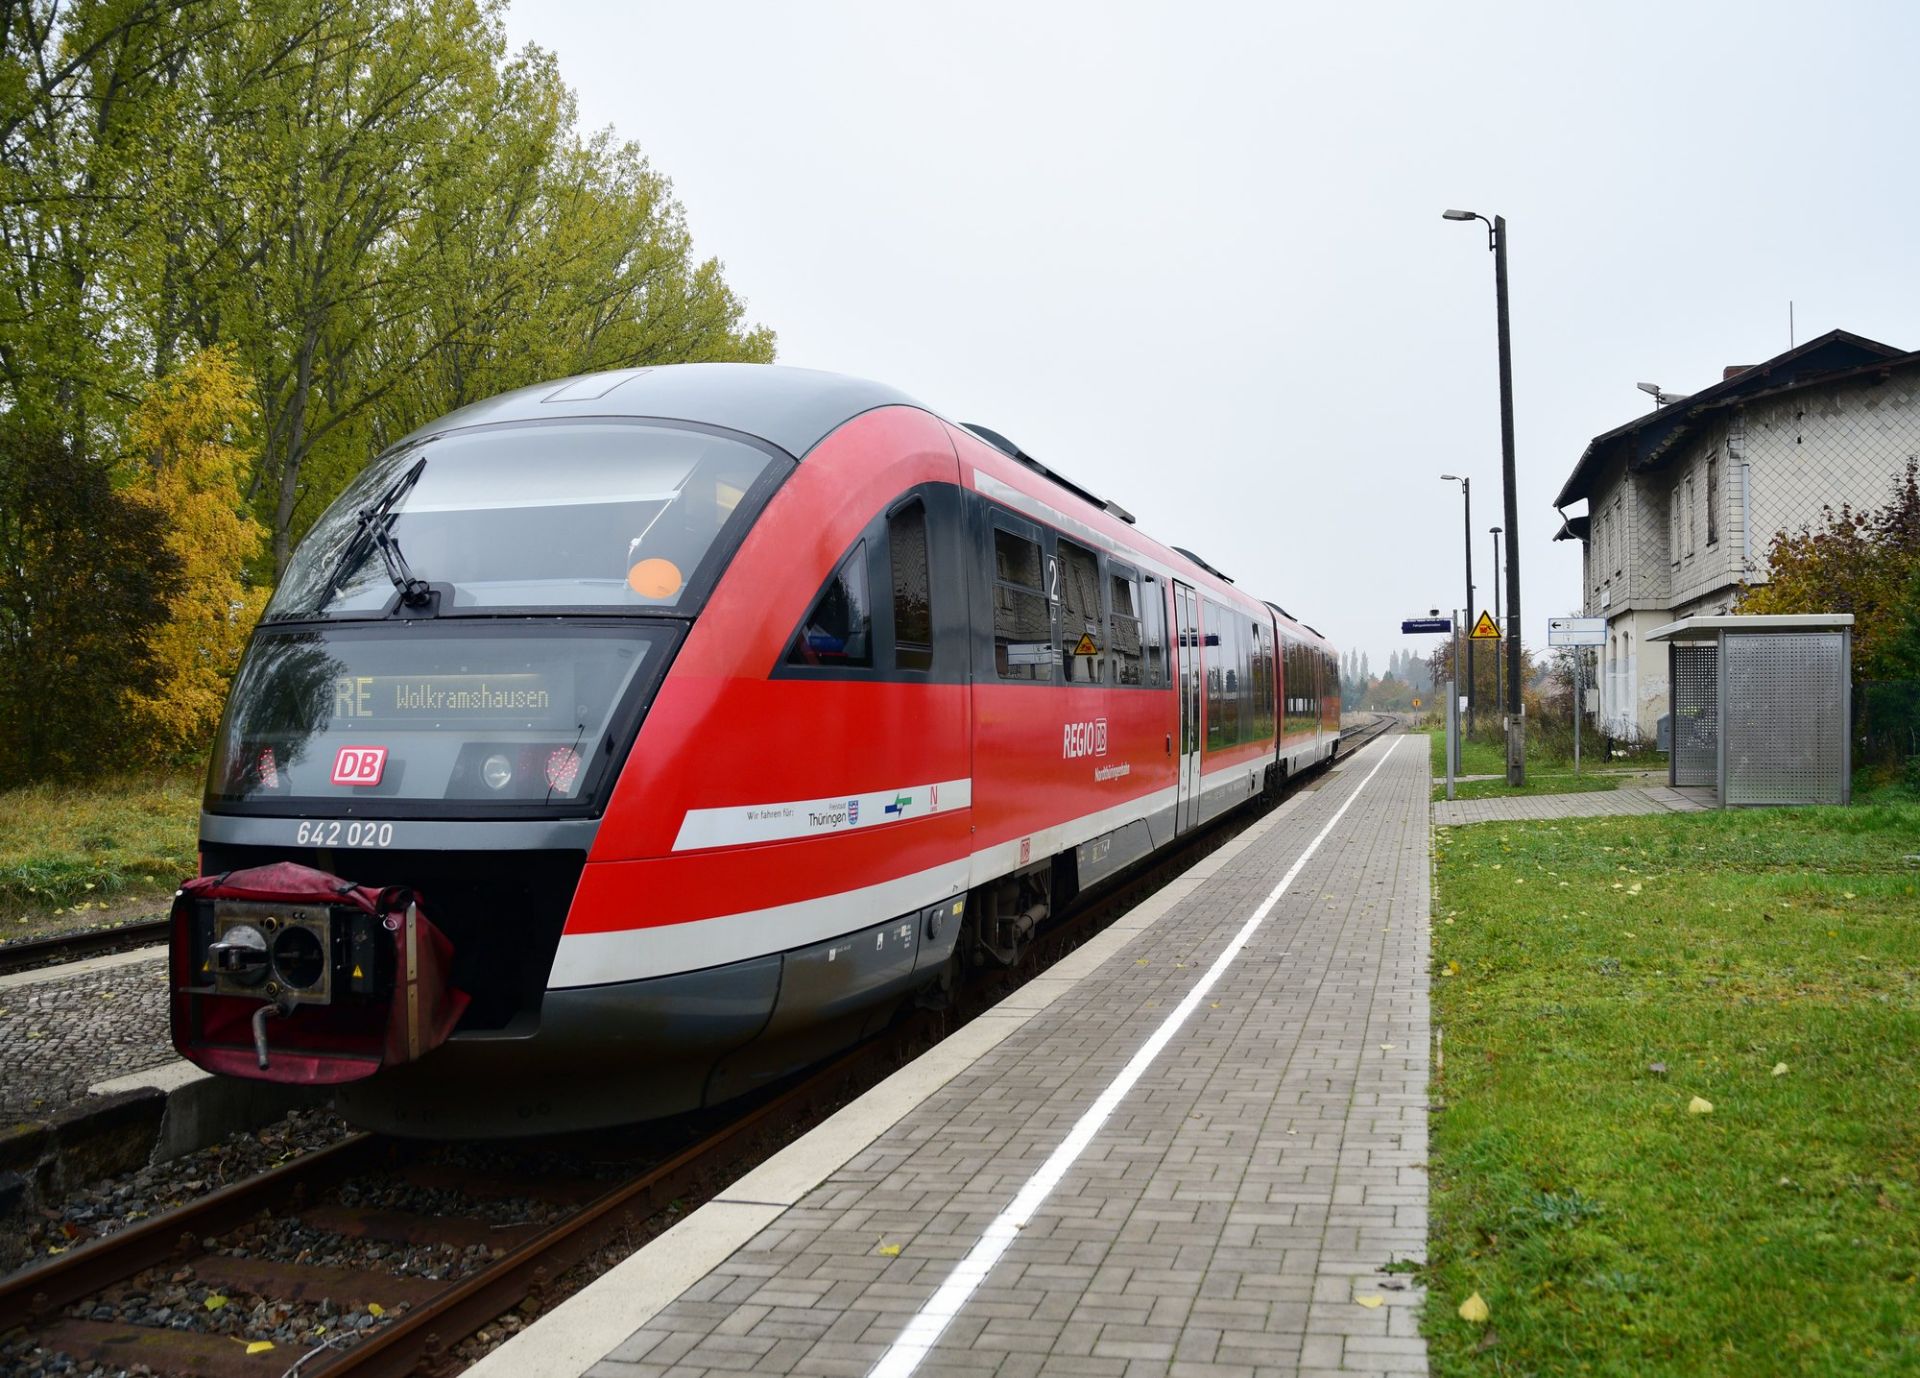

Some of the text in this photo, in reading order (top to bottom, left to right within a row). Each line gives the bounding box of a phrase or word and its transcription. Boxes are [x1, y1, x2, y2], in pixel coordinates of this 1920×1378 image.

[1049, 560, 1058, 600] 2
[335, 677, 549, 717] RE Wolkramshausen
[1063, 722, 1094, 759] REGIO
[337, 752, 379, 779] DB
[747, 811, 759, 820] Wir
[761, 810, 782, 819] fahren
[808, 812, 847, 827] Thüringen
[296, 821, 393, 847] 642 020
